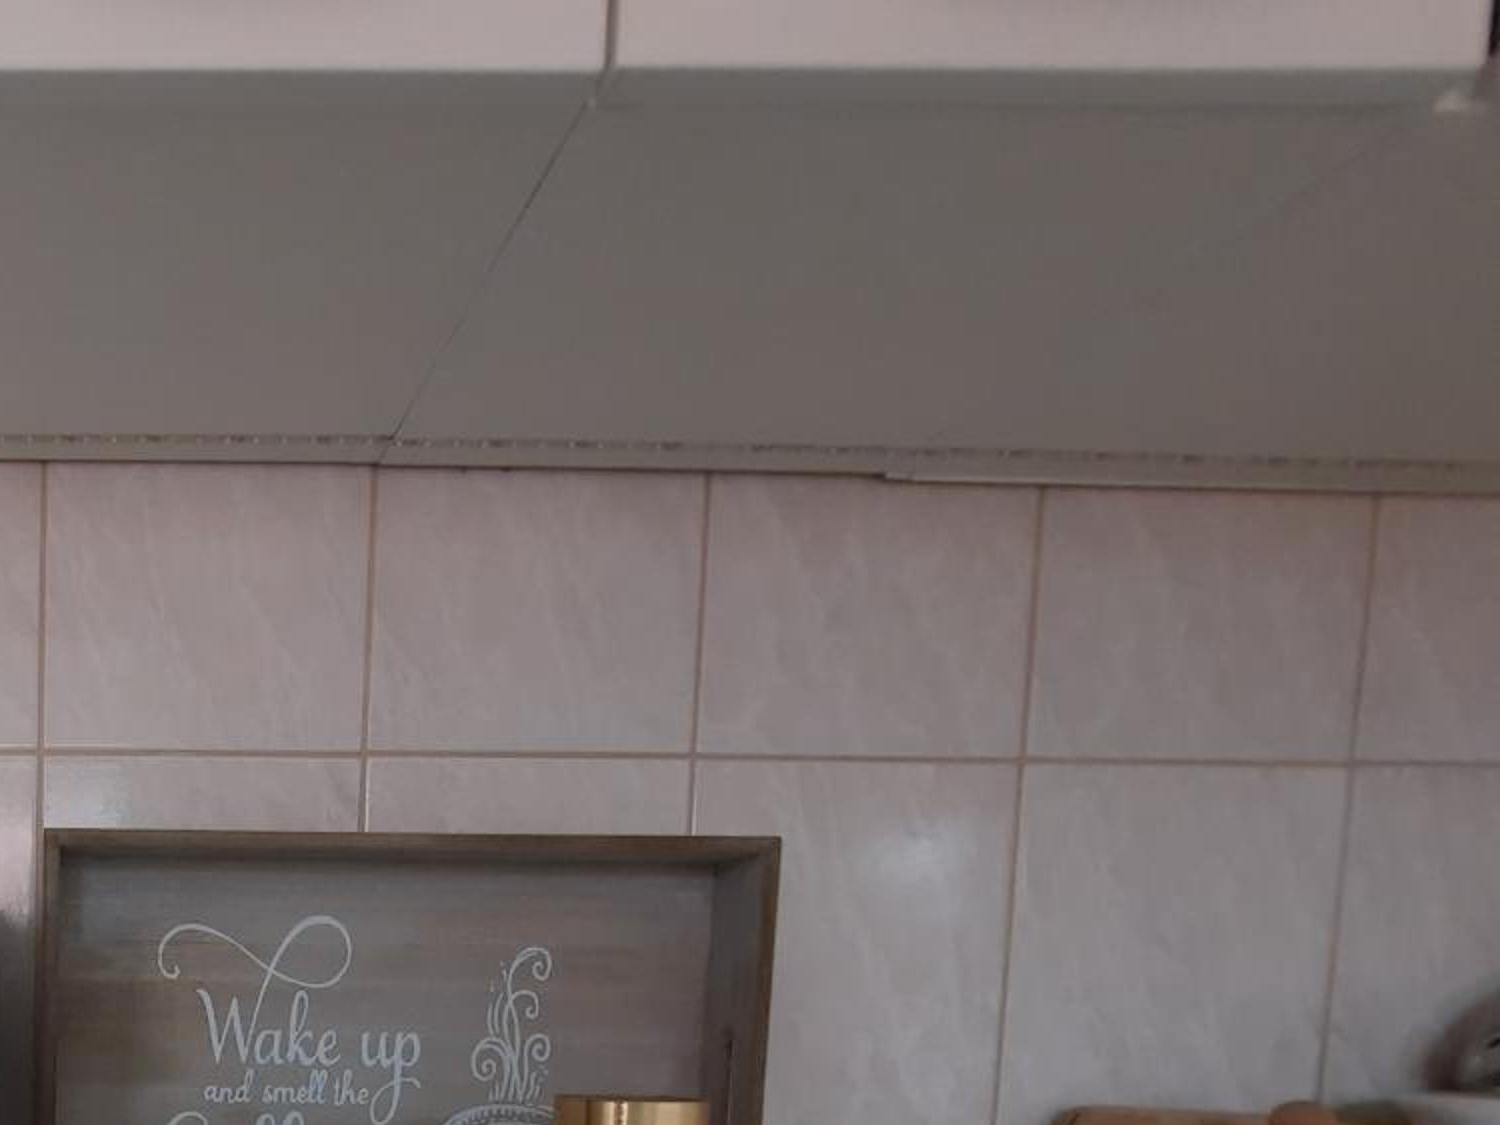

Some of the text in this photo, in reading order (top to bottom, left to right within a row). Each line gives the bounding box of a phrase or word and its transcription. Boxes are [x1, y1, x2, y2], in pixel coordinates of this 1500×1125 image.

[203, 1067, 370, 1106] and smell the
